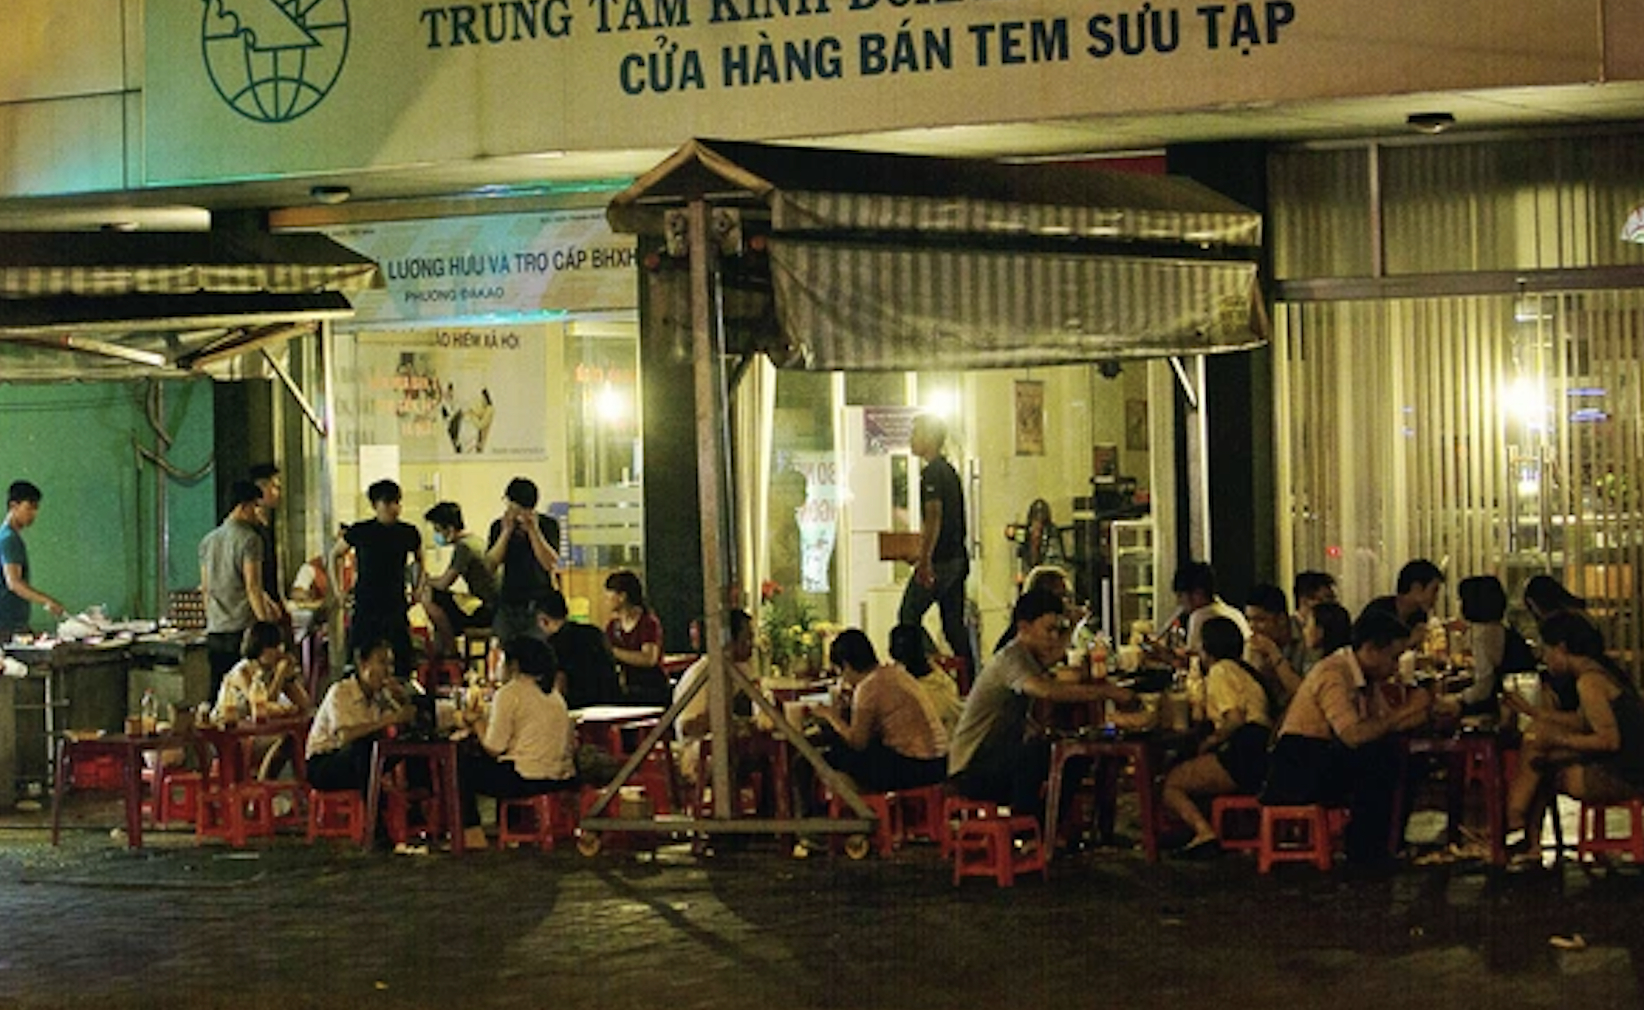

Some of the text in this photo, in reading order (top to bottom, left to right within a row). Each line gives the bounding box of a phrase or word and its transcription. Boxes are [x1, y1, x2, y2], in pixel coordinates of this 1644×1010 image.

[420, 0, 573, 48] TRUNG
[618, 2, 1296, 96] CỬA HÀNG BÁN TEM SƯU TẠP
